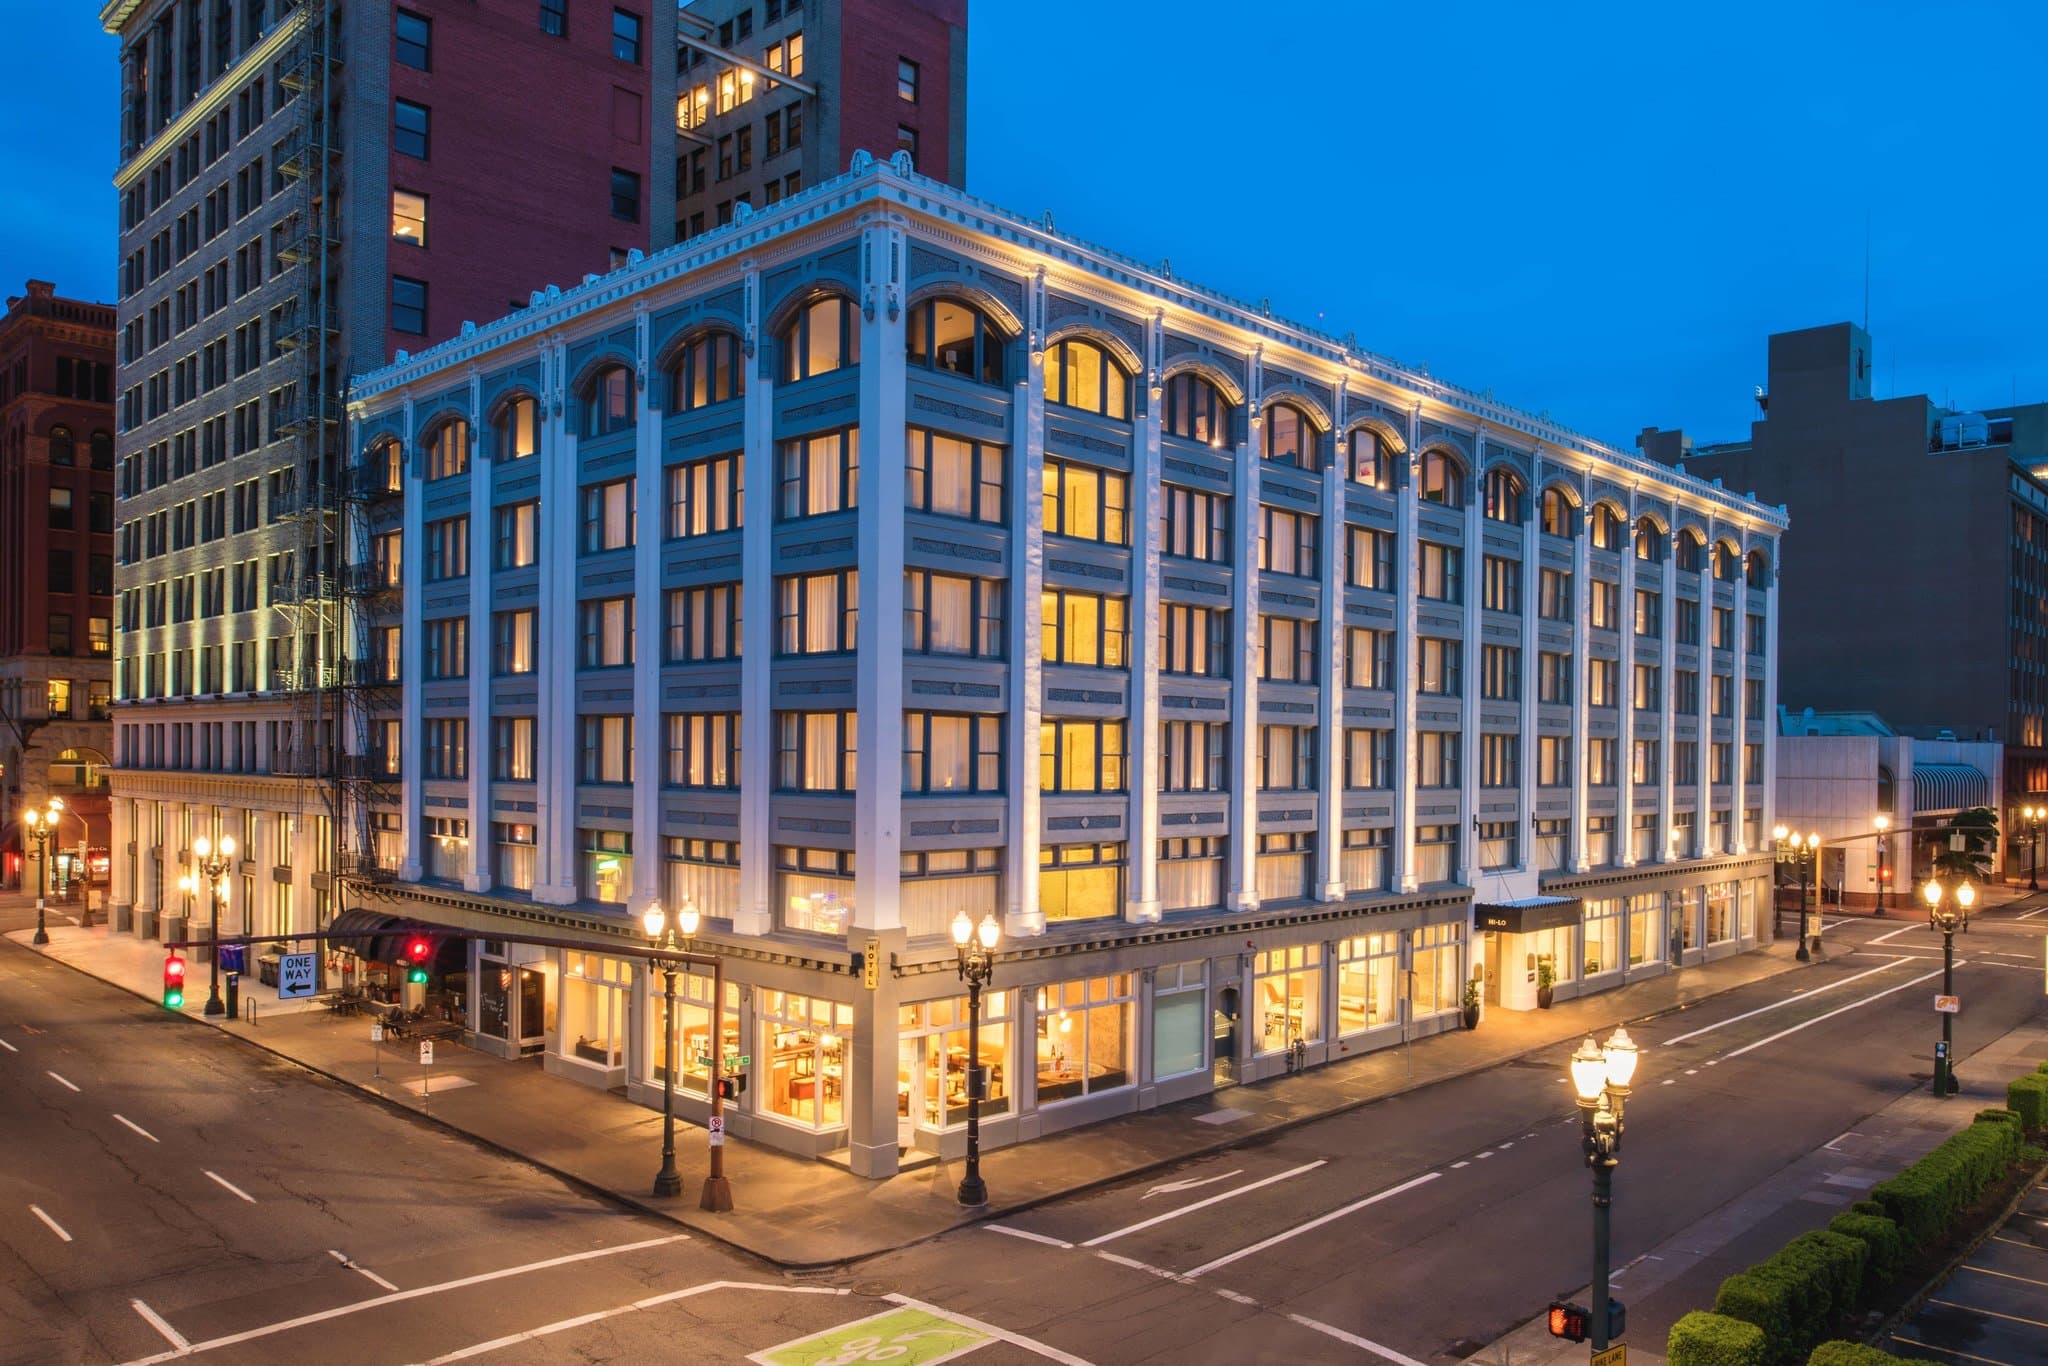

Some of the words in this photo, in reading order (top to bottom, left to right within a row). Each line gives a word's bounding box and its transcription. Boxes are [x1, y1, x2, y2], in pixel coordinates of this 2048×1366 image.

[286, 957, 311, 968] ONE
[285, 968, 311, 980] WAY
[1608, 1350, 1623, 1364] LANE
